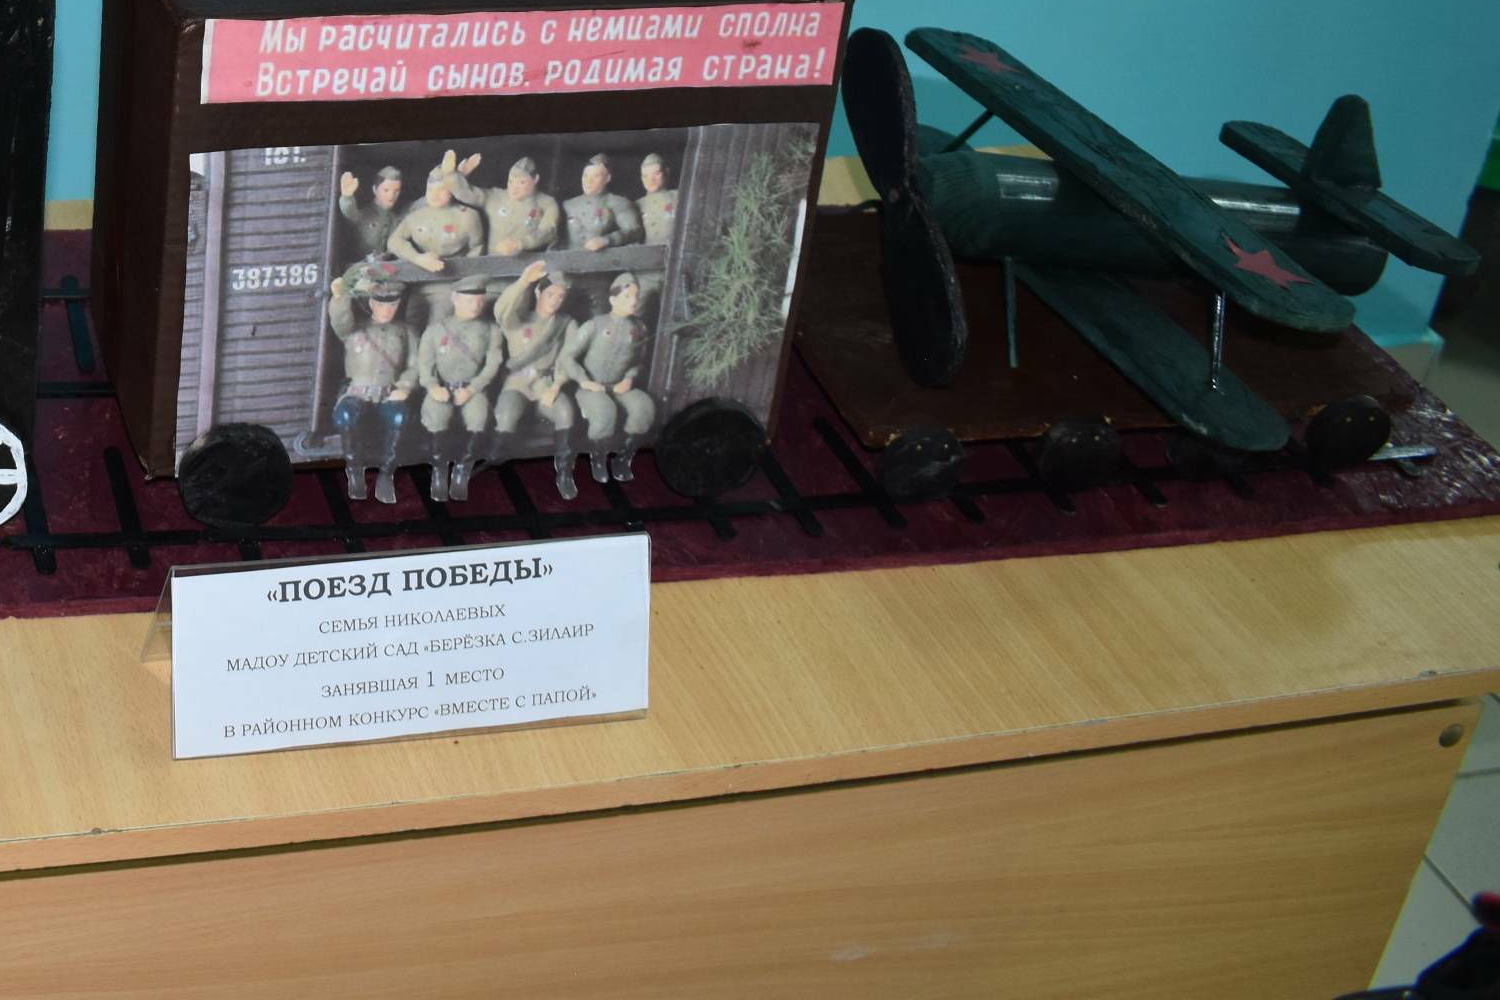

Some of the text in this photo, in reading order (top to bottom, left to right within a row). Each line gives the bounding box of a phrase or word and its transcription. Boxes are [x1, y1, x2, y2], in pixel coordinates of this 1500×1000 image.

[259, 11, 821, 53] Мы расчитались с немцами сполна
[255, 59, 408, 97] Встречай
[544, 56, 683, 86] родимая
[703, 47, 826, 81] страна!
[232, 263, 318, 290] 387386
[266, 557, 553, 603] «ПОЕЗД ПОБЕДЫ»
[318, 604, 506, 634] СЕМЬЯ НИКОЛАЕВЫХ
[226, 623, 594, 672] МАДОУ ДЕТСКИЙ САД «БЕРЁЗКА С.ЗИЛАИР
[321, 667, 505, 698] ЗАНЯВШАЯ 1 МЕСТО
[224, 685, 597, 738] В РАЙОННОМ КОНКУРС «ВМЕСТЕ С ПАПОЙ»
